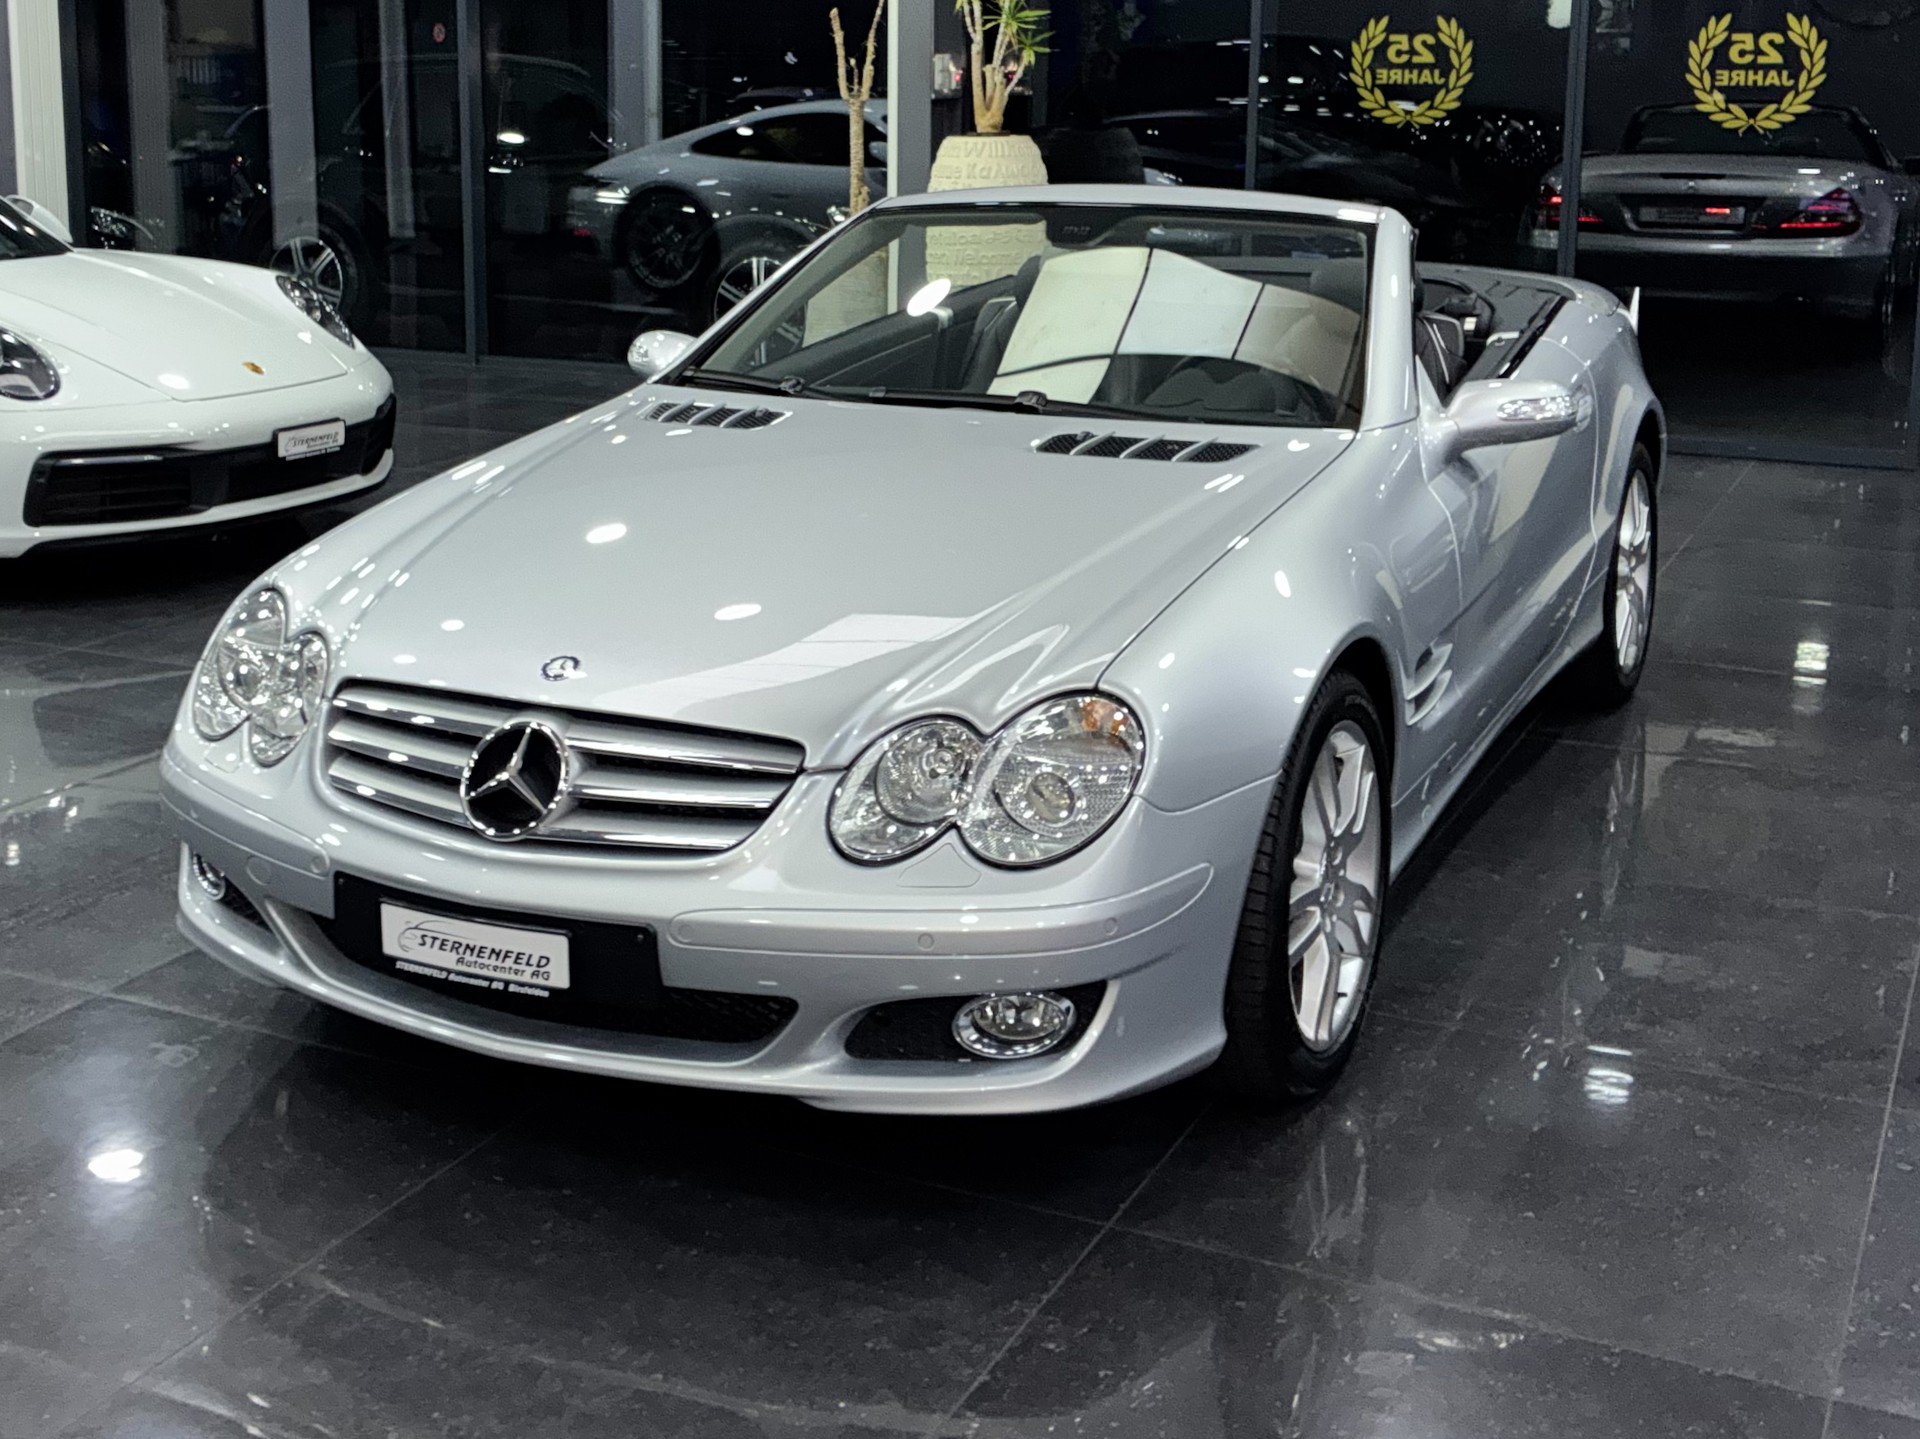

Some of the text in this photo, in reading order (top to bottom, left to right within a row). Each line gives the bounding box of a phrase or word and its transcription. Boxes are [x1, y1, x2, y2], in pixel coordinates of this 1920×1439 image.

[418, 934, 551, 969] STERNENFELD
[456, 957, 551, 982] Autocenter AG
